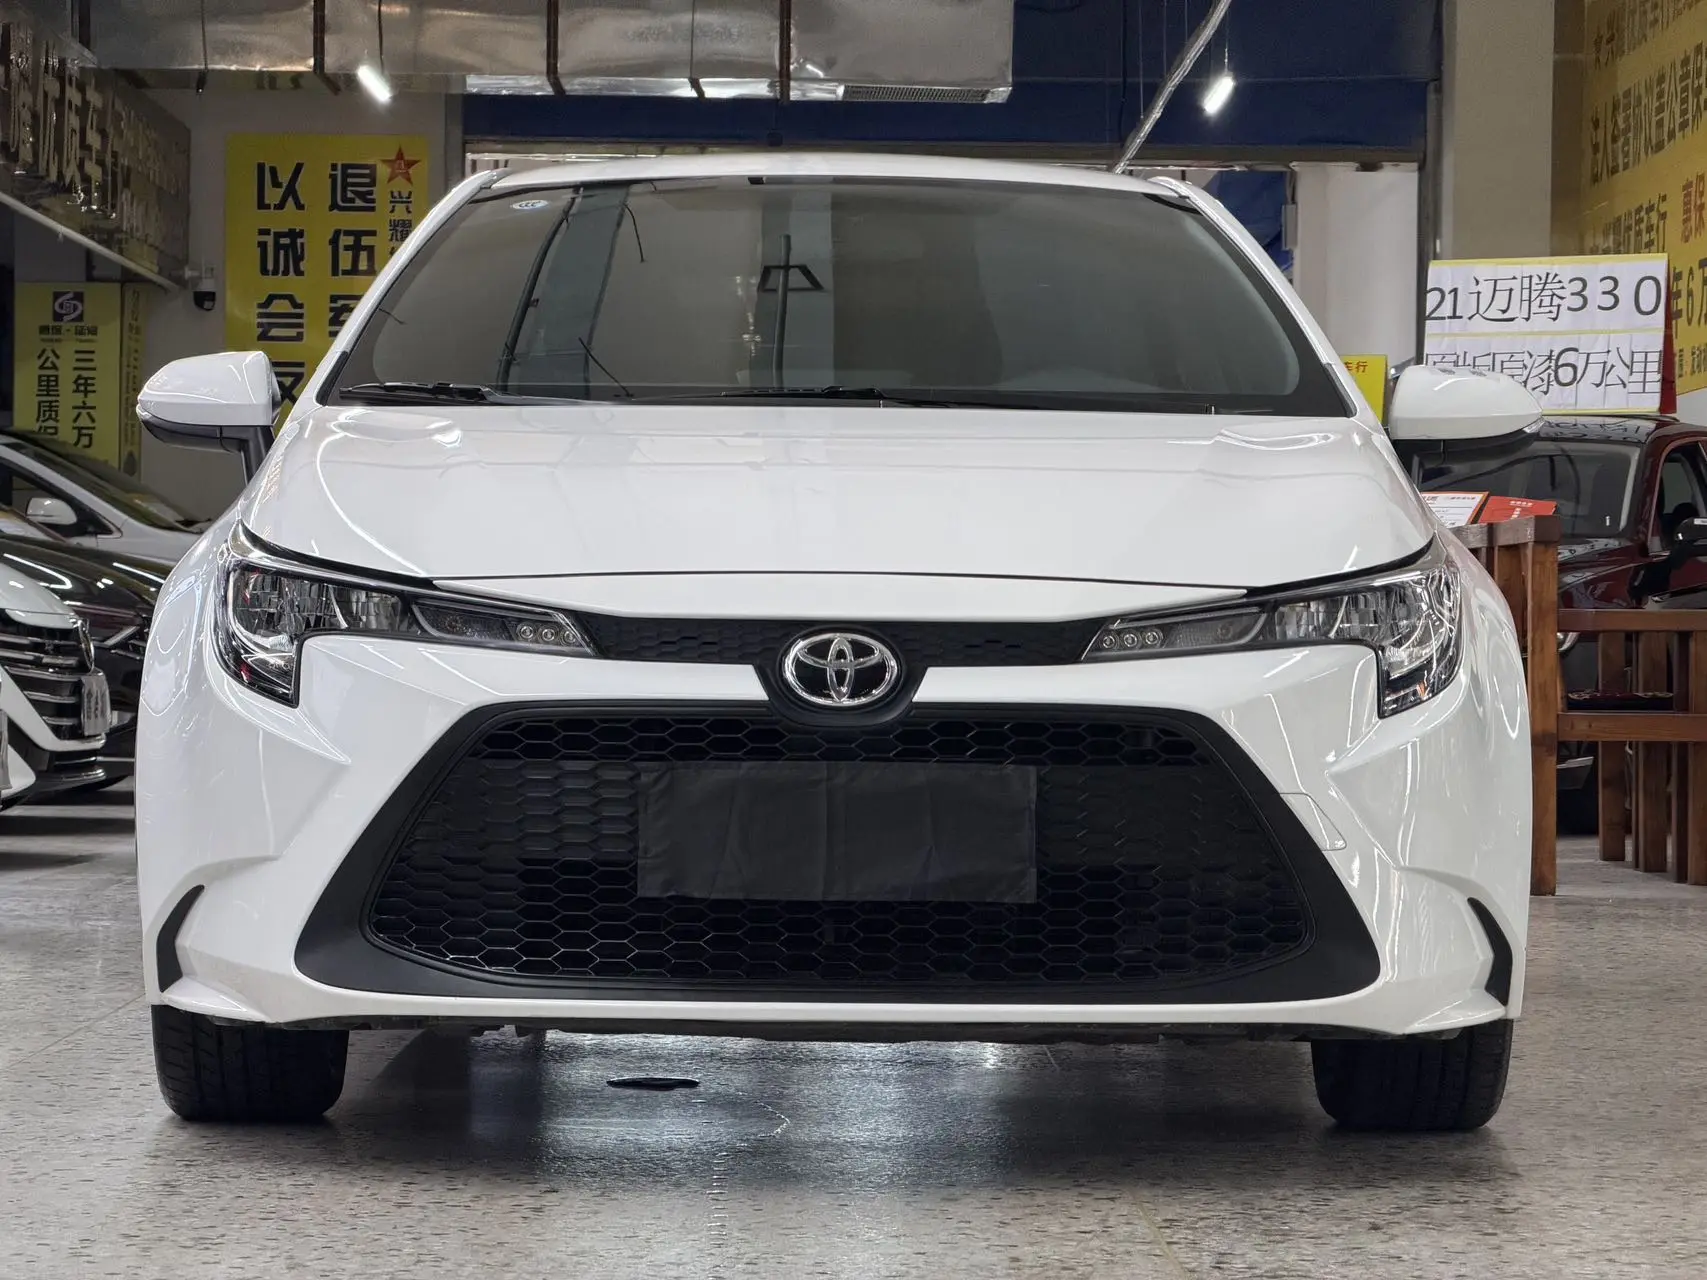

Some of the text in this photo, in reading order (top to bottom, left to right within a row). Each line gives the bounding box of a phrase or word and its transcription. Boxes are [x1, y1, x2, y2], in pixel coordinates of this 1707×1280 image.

[389, 190, 412, 257] 兴耀
[1425, 271, 1662, 323] 21迈腾330
[72, 349, 97, 448] 三年六万
